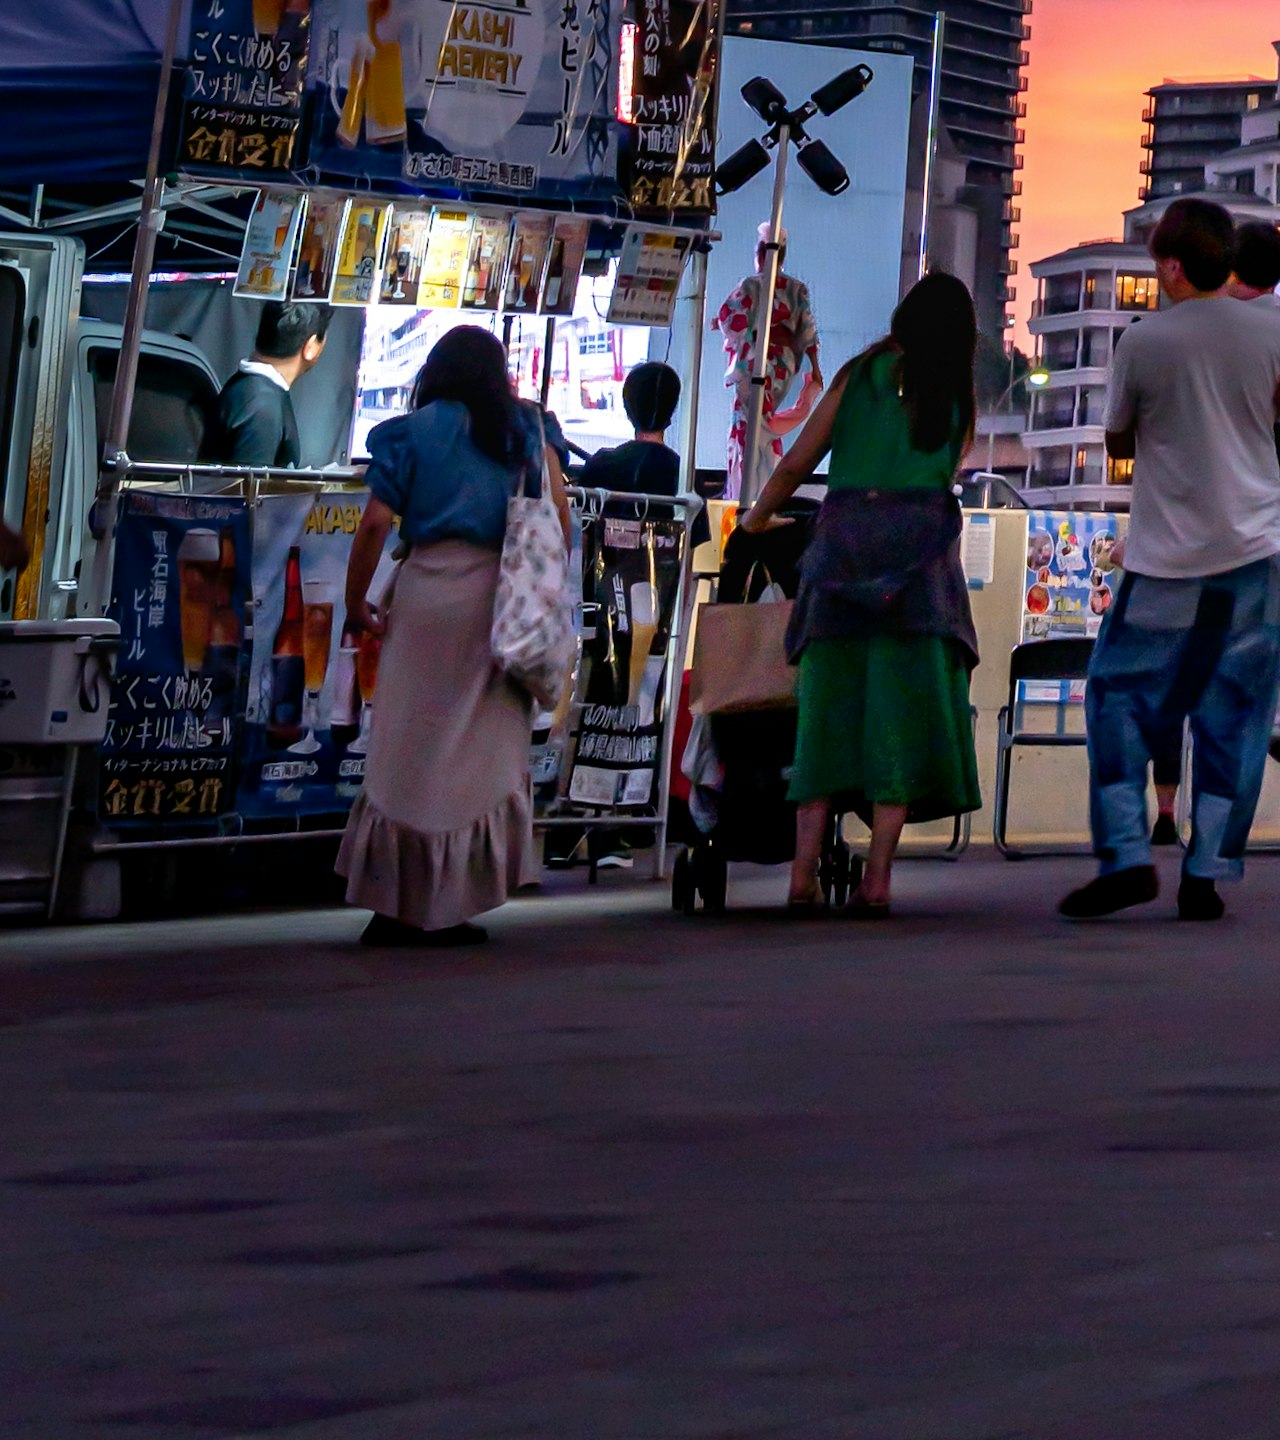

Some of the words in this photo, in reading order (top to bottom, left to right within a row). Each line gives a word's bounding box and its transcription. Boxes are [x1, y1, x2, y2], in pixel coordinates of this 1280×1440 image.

[147, 530, 169, 629] 明石海岸
[127, 587, 147, 662] ビール
